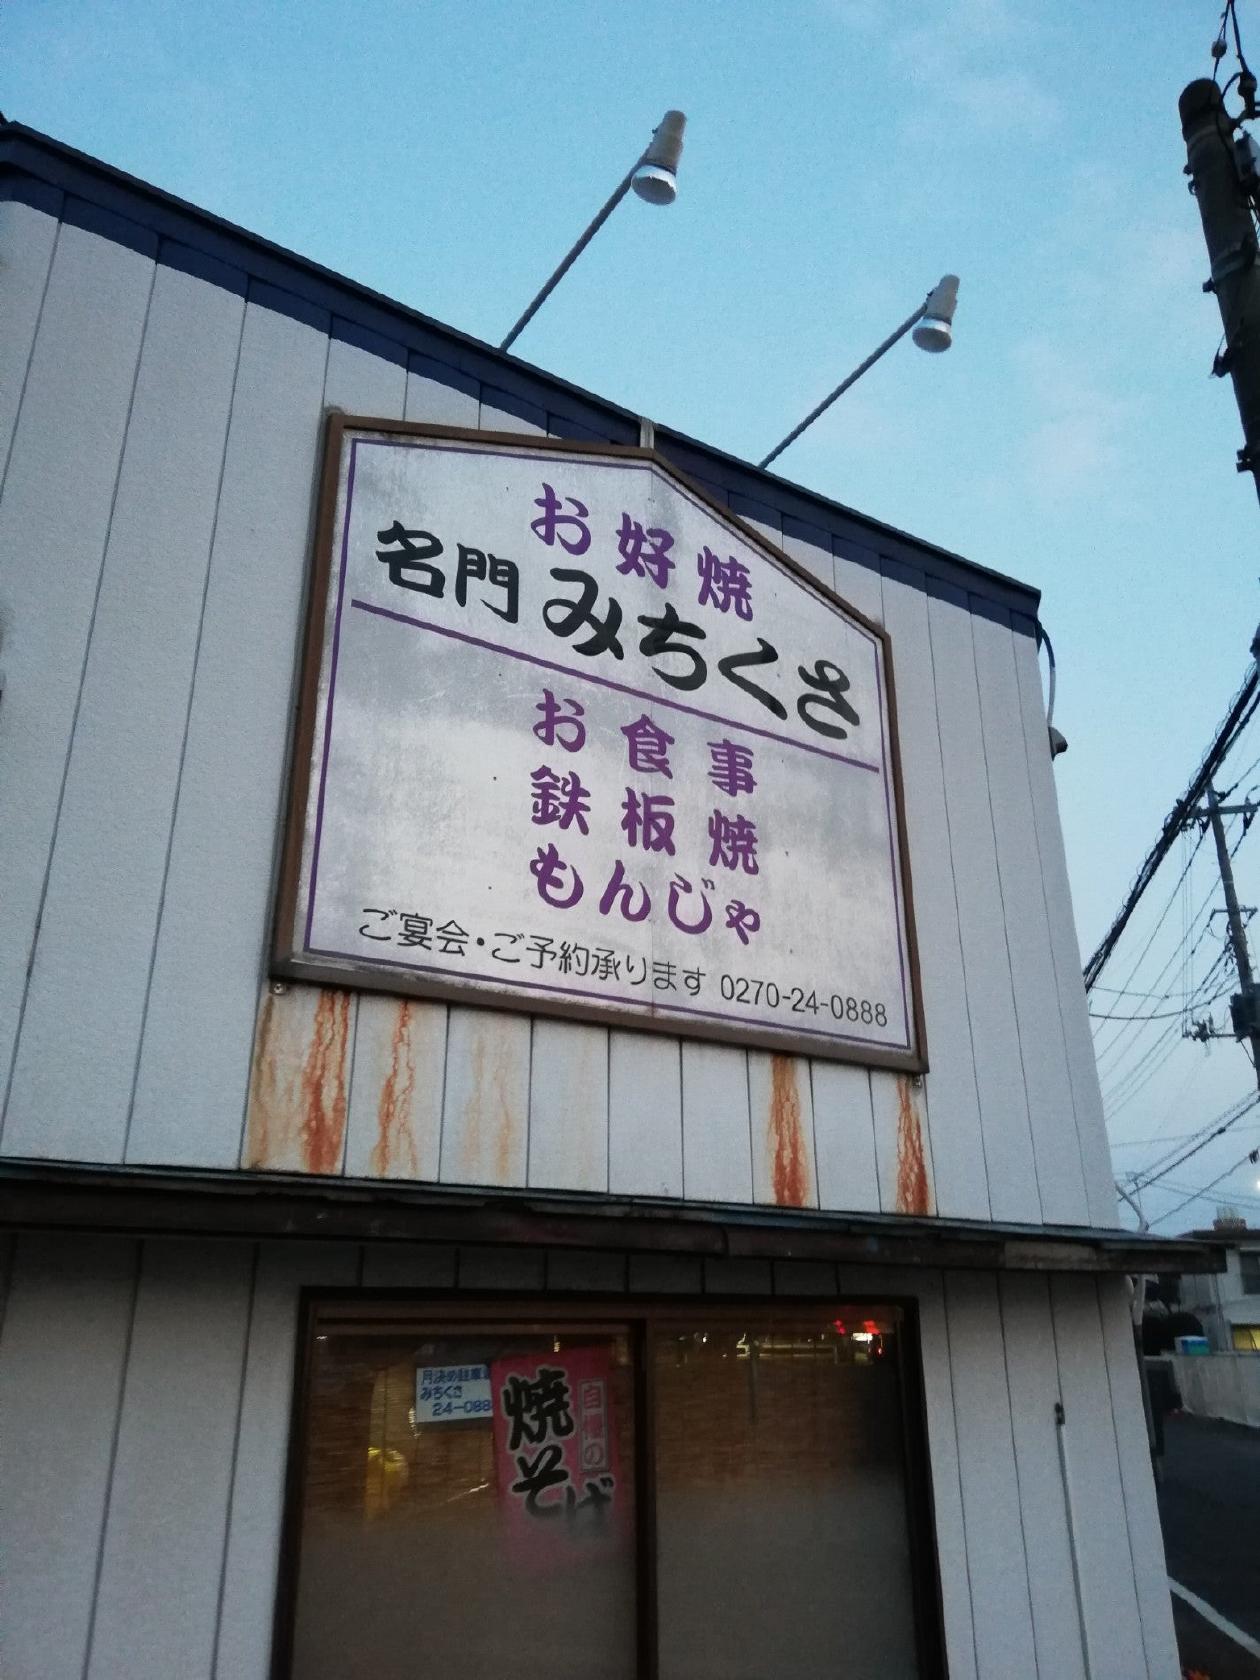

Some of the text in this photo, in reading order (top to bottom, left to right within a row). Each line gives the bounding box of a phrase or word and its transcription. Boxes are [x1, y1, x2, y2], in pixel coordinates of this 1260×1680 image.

[530, 482, 755, 622] お好焼
[532, 688, 757, 798] お食事
[529, 765, 760, 876] 鉄板焼
[530, 843, 761, 945] もんじゃ
[719, 974, 889, 1029] 0270-24-0888
